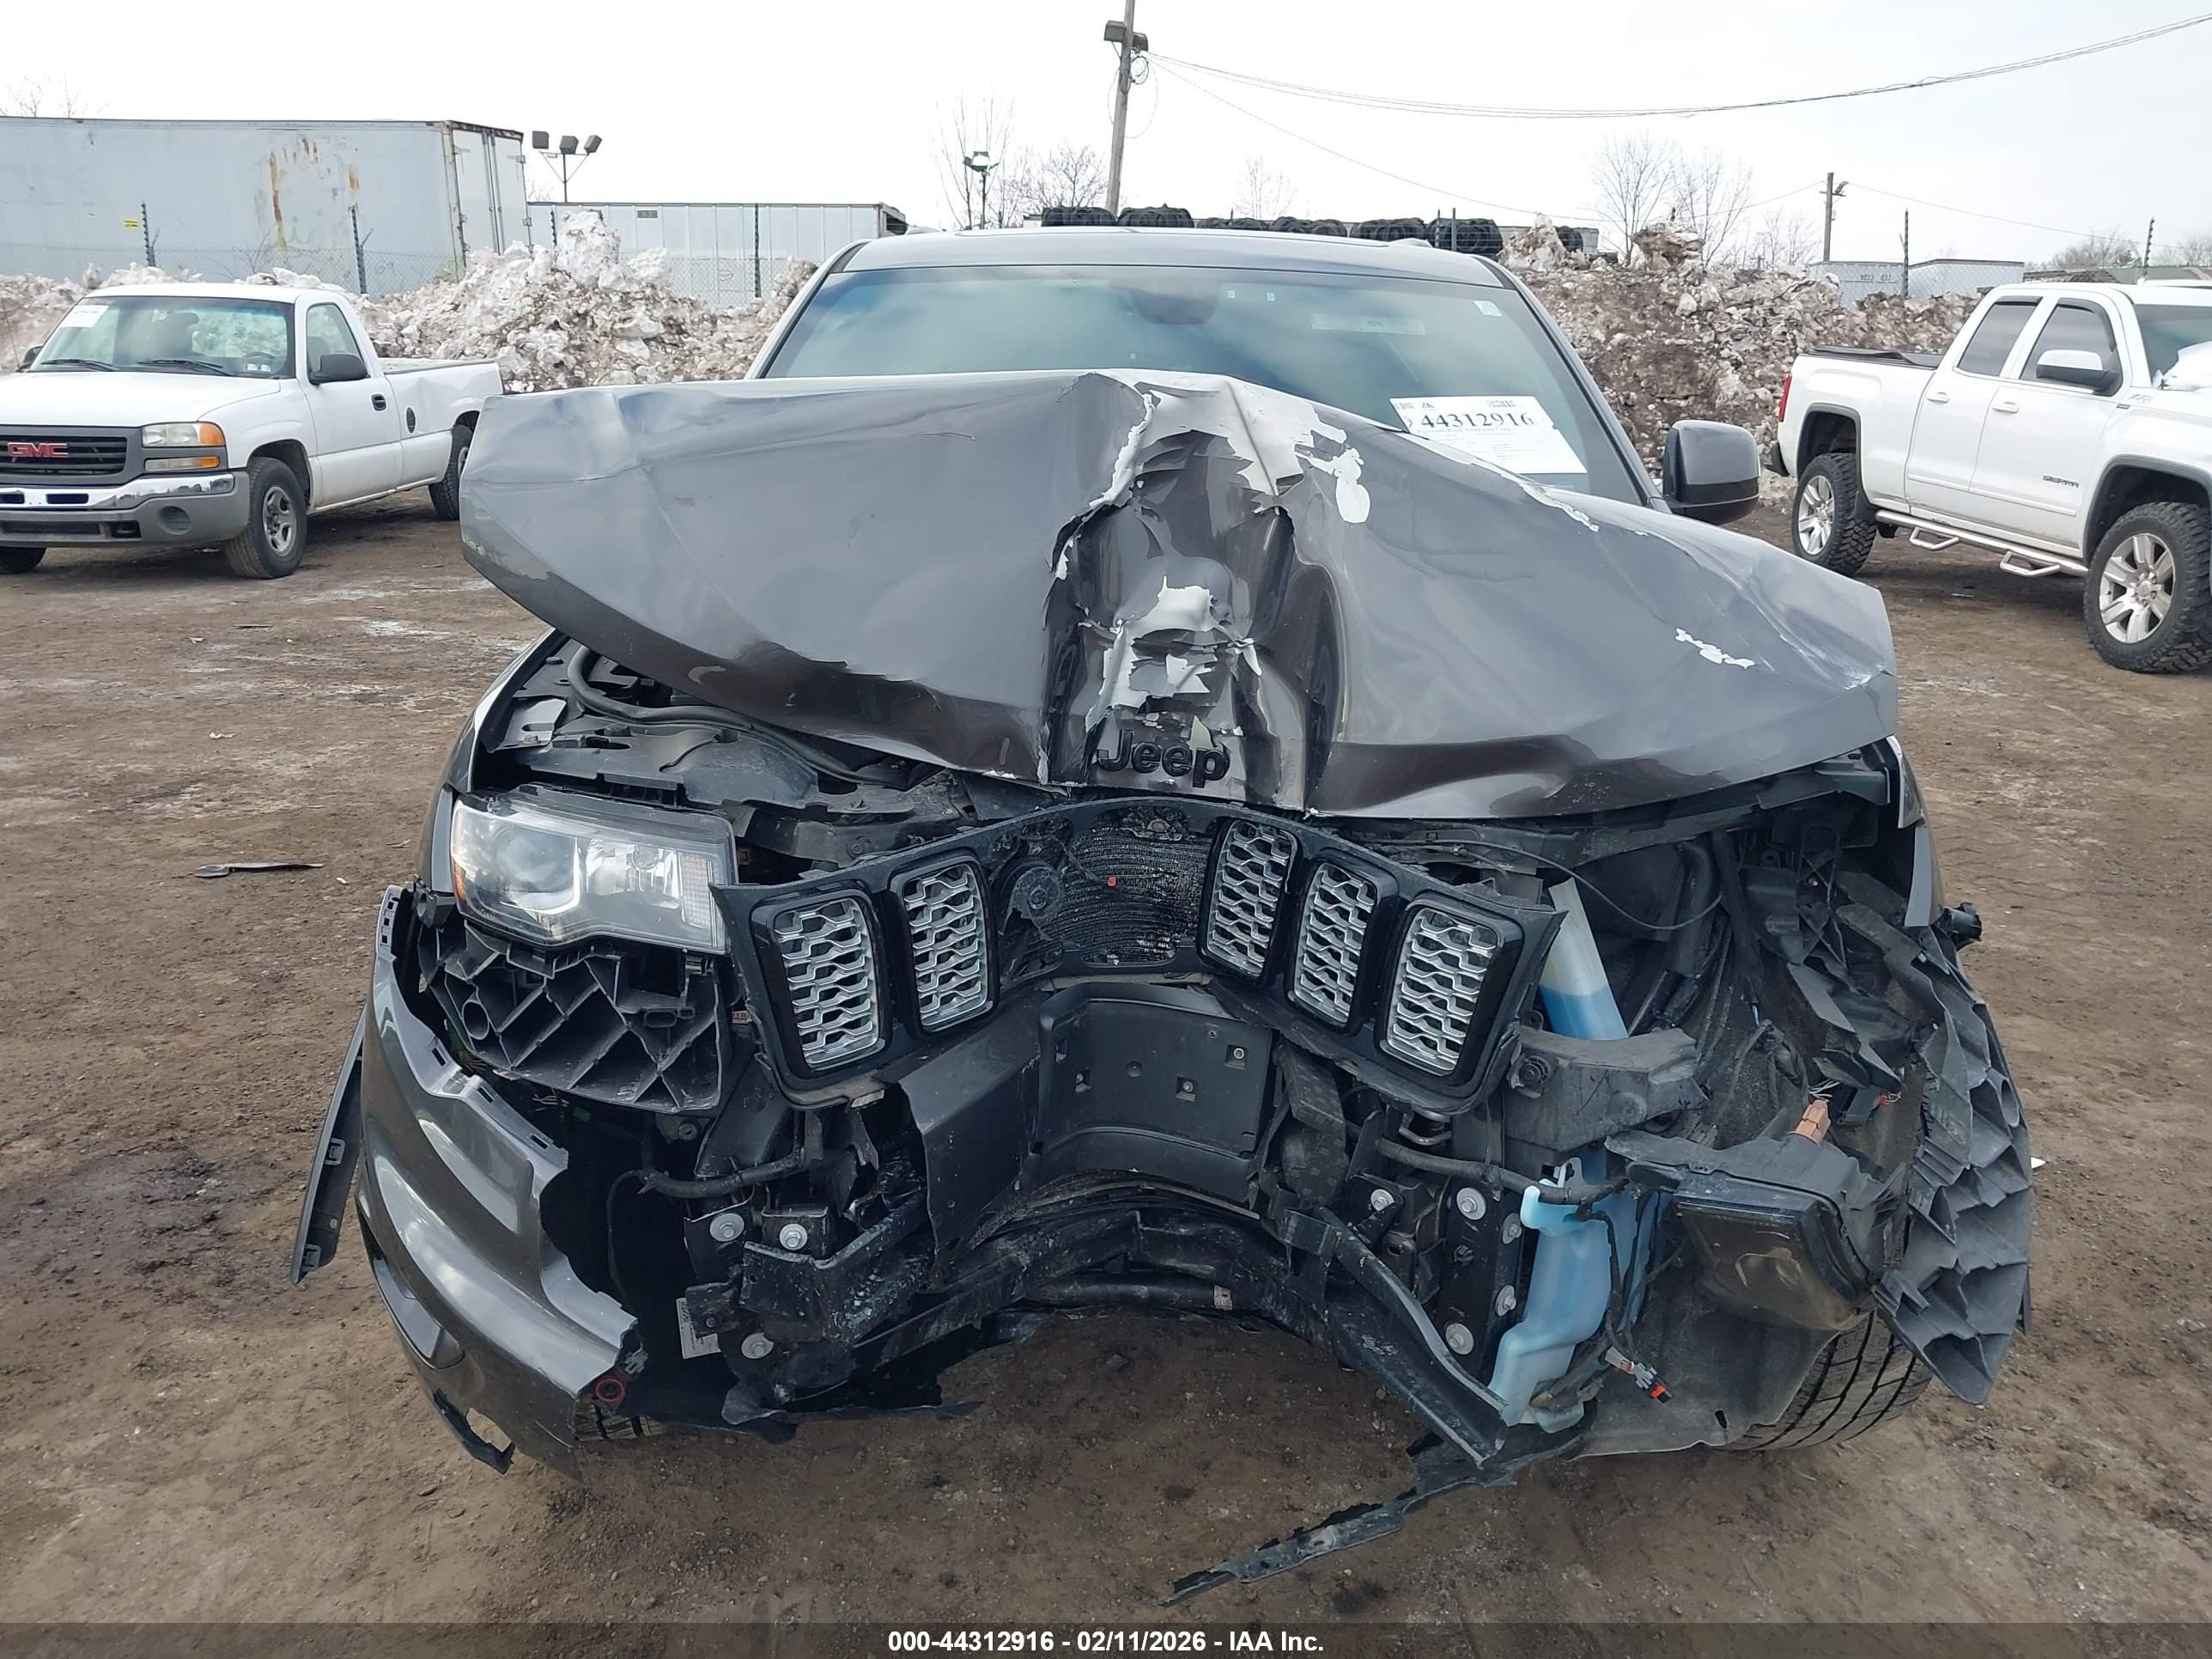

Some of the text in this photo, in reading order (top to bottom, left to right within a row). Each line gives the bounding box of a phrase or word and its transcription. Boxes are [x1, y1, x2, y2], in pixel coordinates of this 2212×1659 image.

[1421, 412, 1534, 428] 44312916
[7, 441, 69, 458] GMC
[1097, 728, 1231, 788] Jeep
